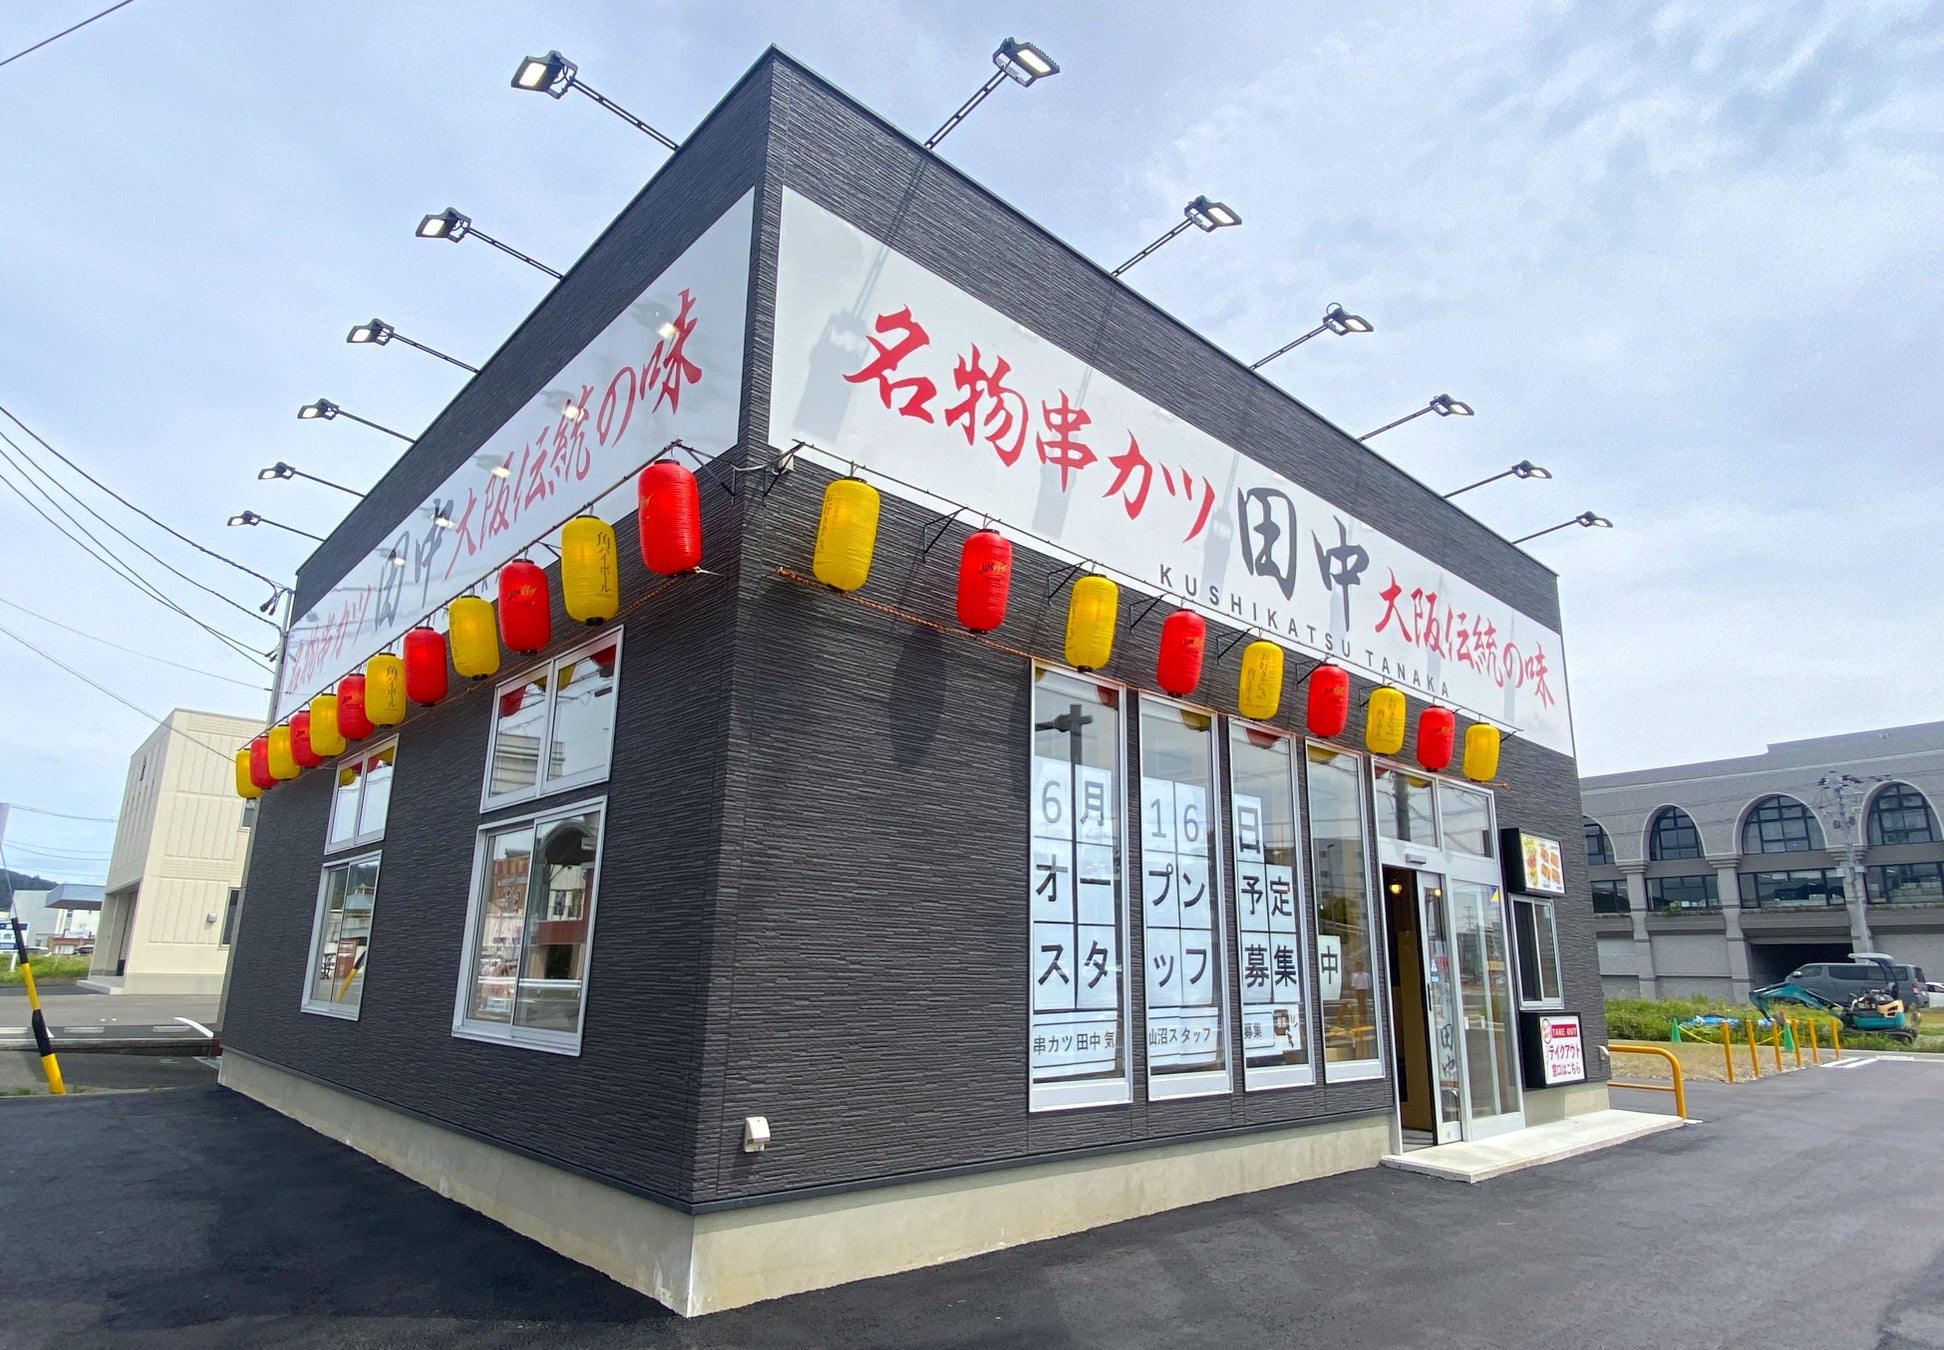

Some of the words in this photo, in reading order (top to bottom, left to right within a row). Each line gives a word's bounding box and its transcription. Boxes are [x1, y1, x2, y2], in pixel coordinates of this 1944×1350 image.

[1160, 564, 1351, 658] KUSHIKATSU
[1365, 649, 1450, 698] TANAKA
[1374, 566, 1555, 710] 大阪伝統の味
[1549, 1043, 1580, 1060] テイクアウト
[1552, 1028, 1565, 1036] TAKE
[1567, 1027, 1577, 1036] OUT
